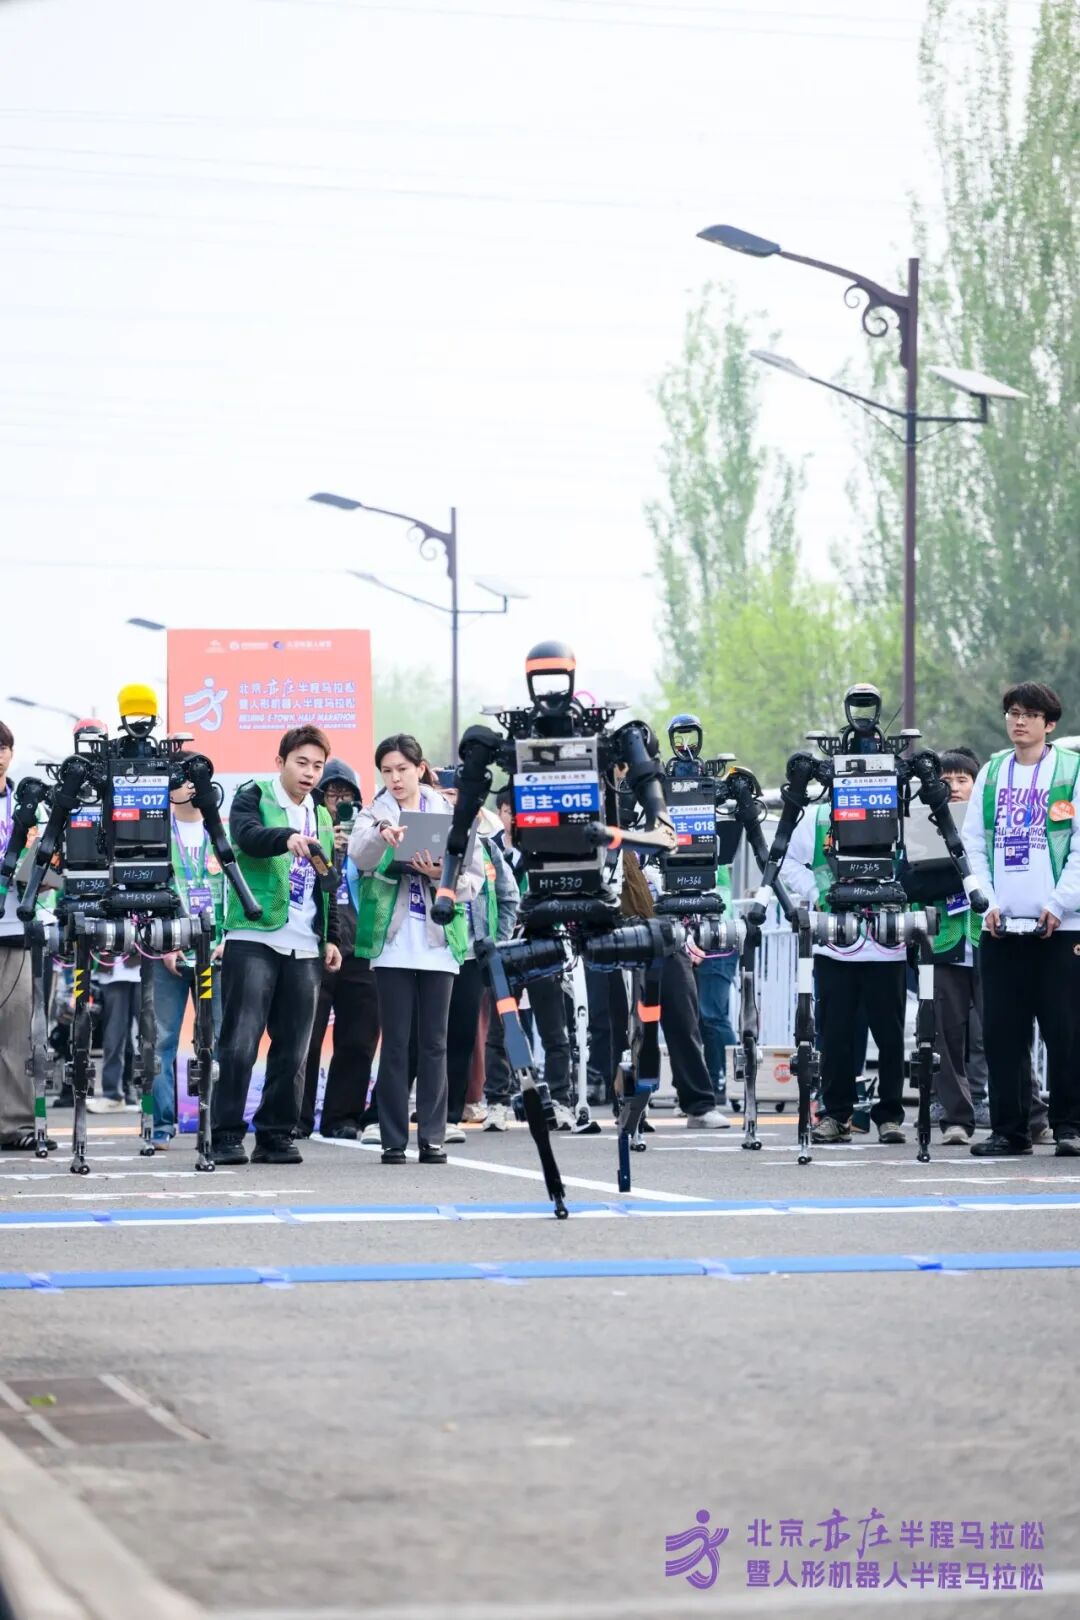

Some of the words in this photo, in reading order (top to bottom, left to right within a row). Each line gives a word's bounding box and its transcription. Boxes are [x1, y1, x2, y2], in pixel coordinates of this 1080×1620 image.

[113, 794, 165, 806] 自主-017
[521, 793, 592, 810] 自主-015
[838, 794, 891, 807] 自主-016
[674, 821, 715, 832] 主-018
